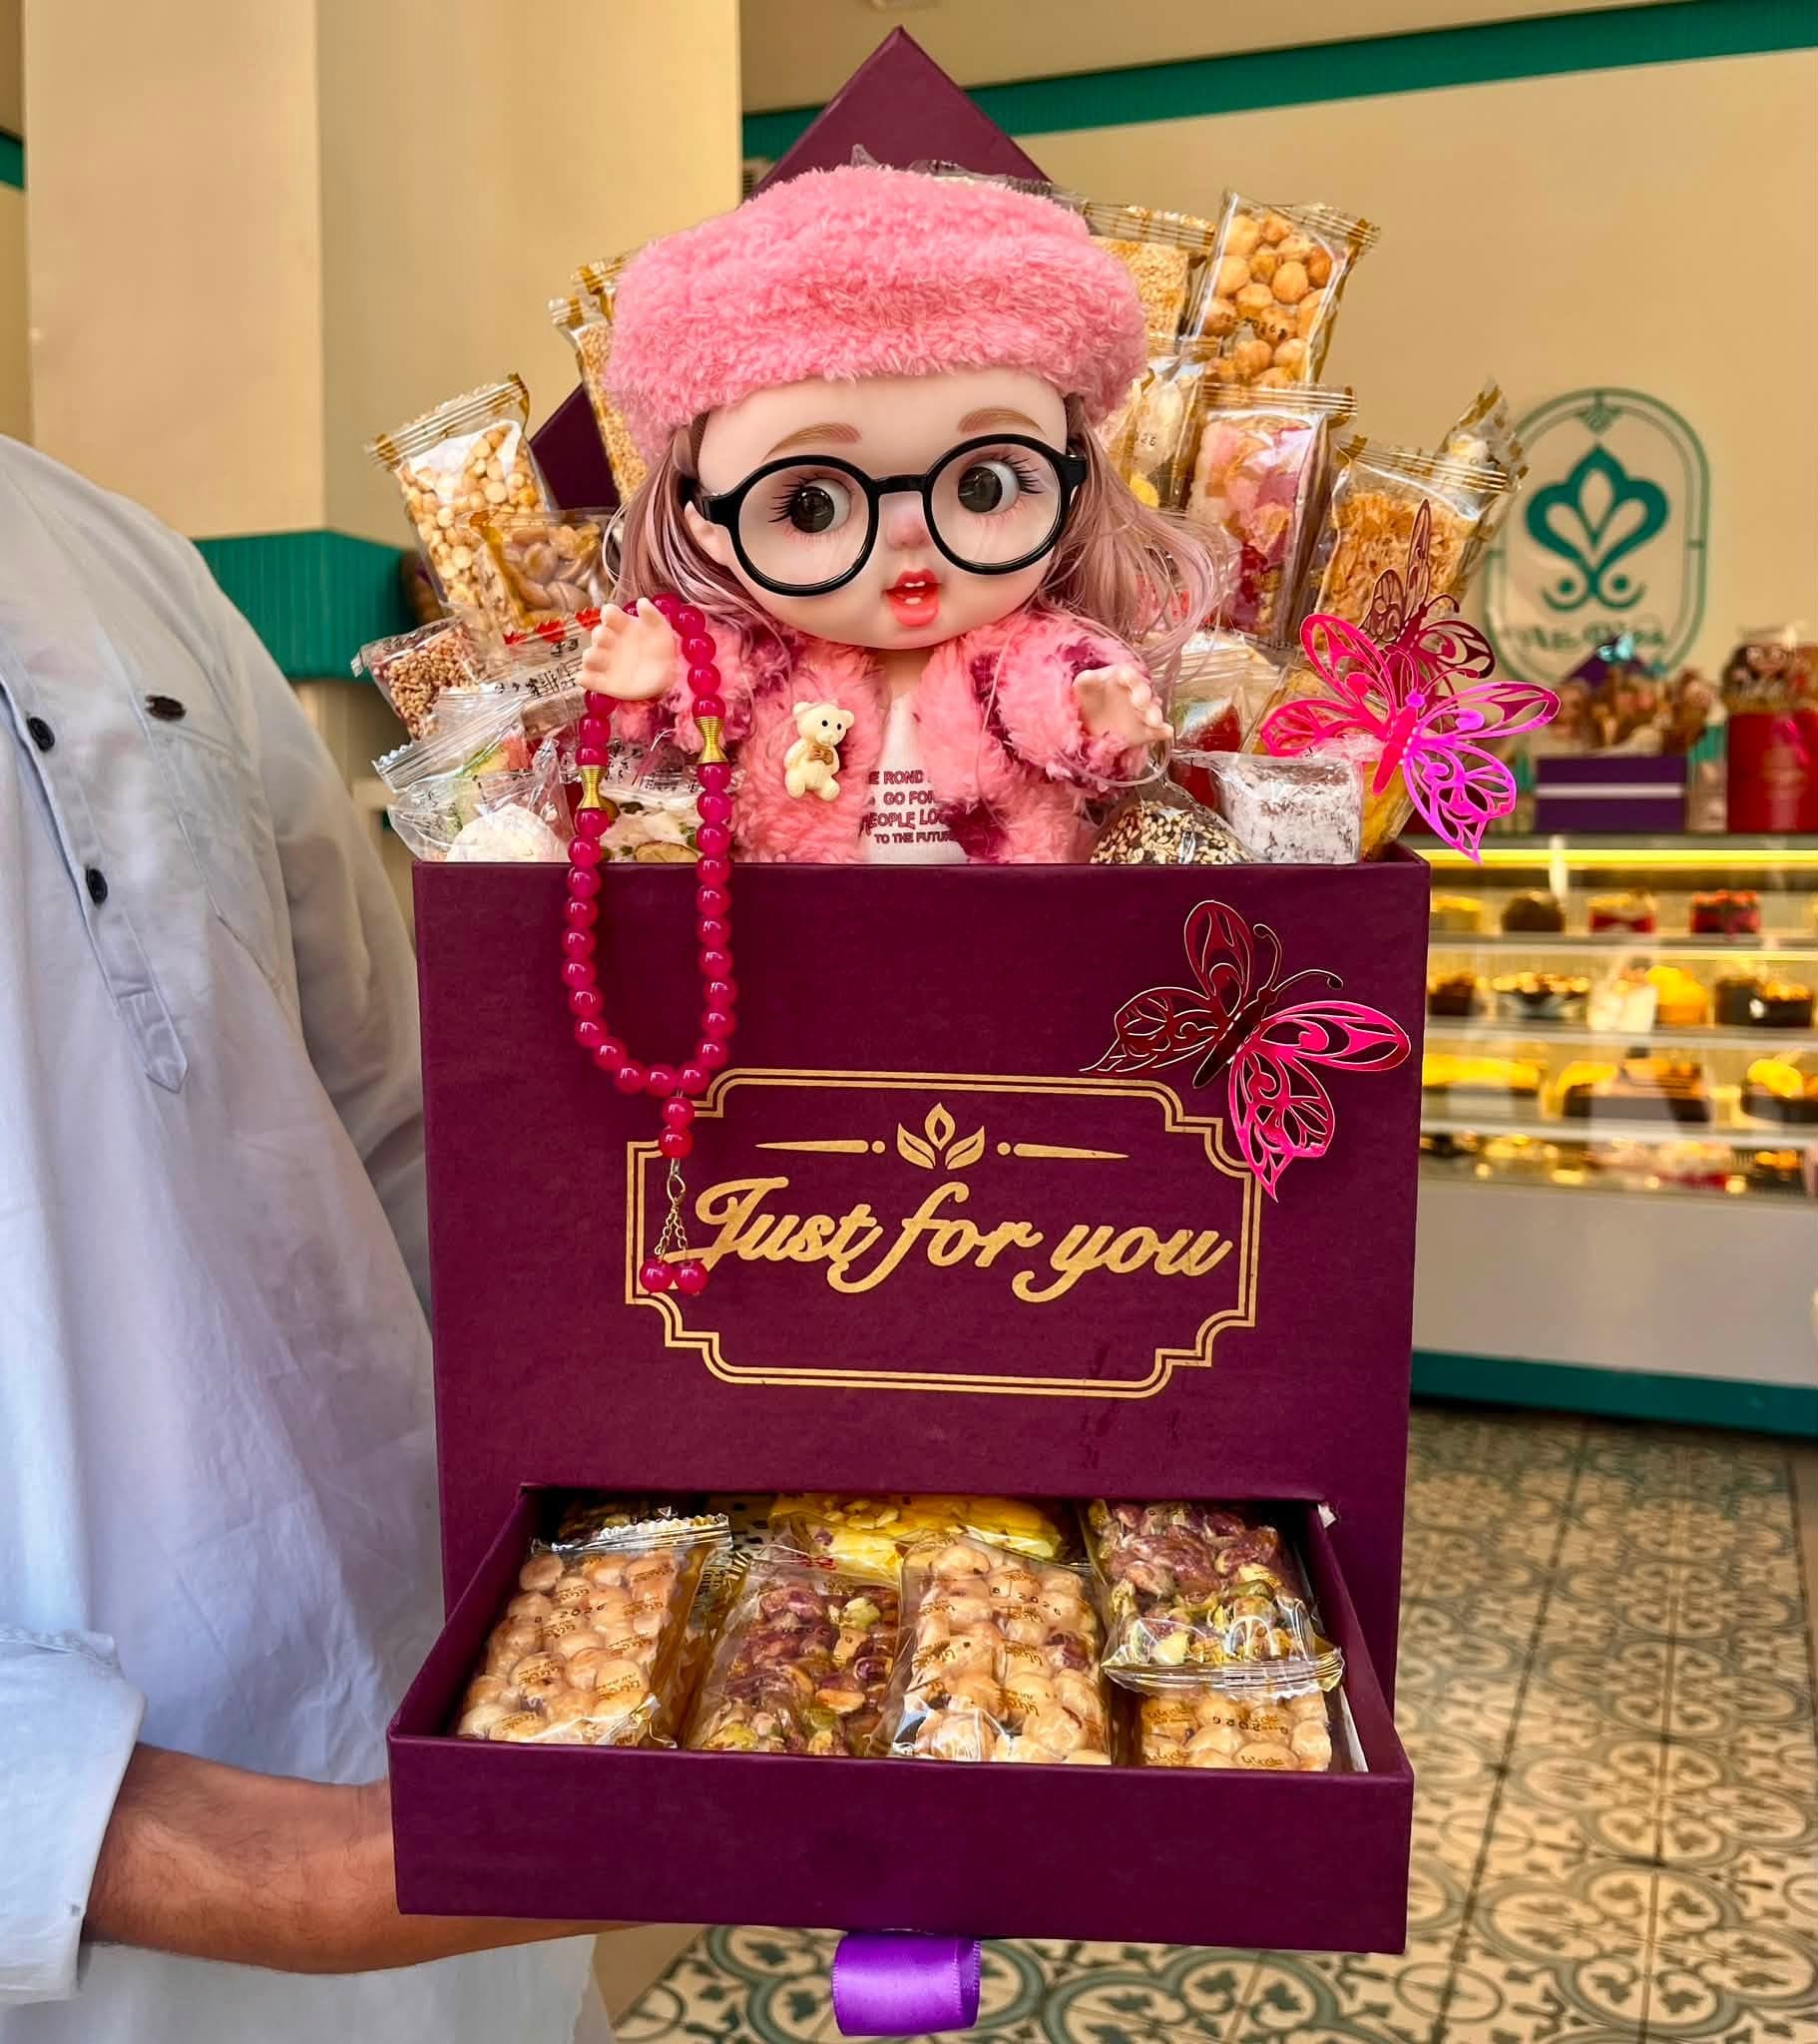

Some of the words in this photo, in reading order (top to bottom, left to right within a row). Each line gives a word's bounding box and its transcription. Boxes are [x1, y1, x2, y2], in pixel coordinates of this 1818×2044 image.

[883, 791, 906, 805] GO
[873, 832, 890, 844] TO
[892, 832, 915, 843] THE
[663, 1176, 884, 1287] Just
[826, 1182, 1043, 1293] for
[1012, 1224, 1233, 1303] you
